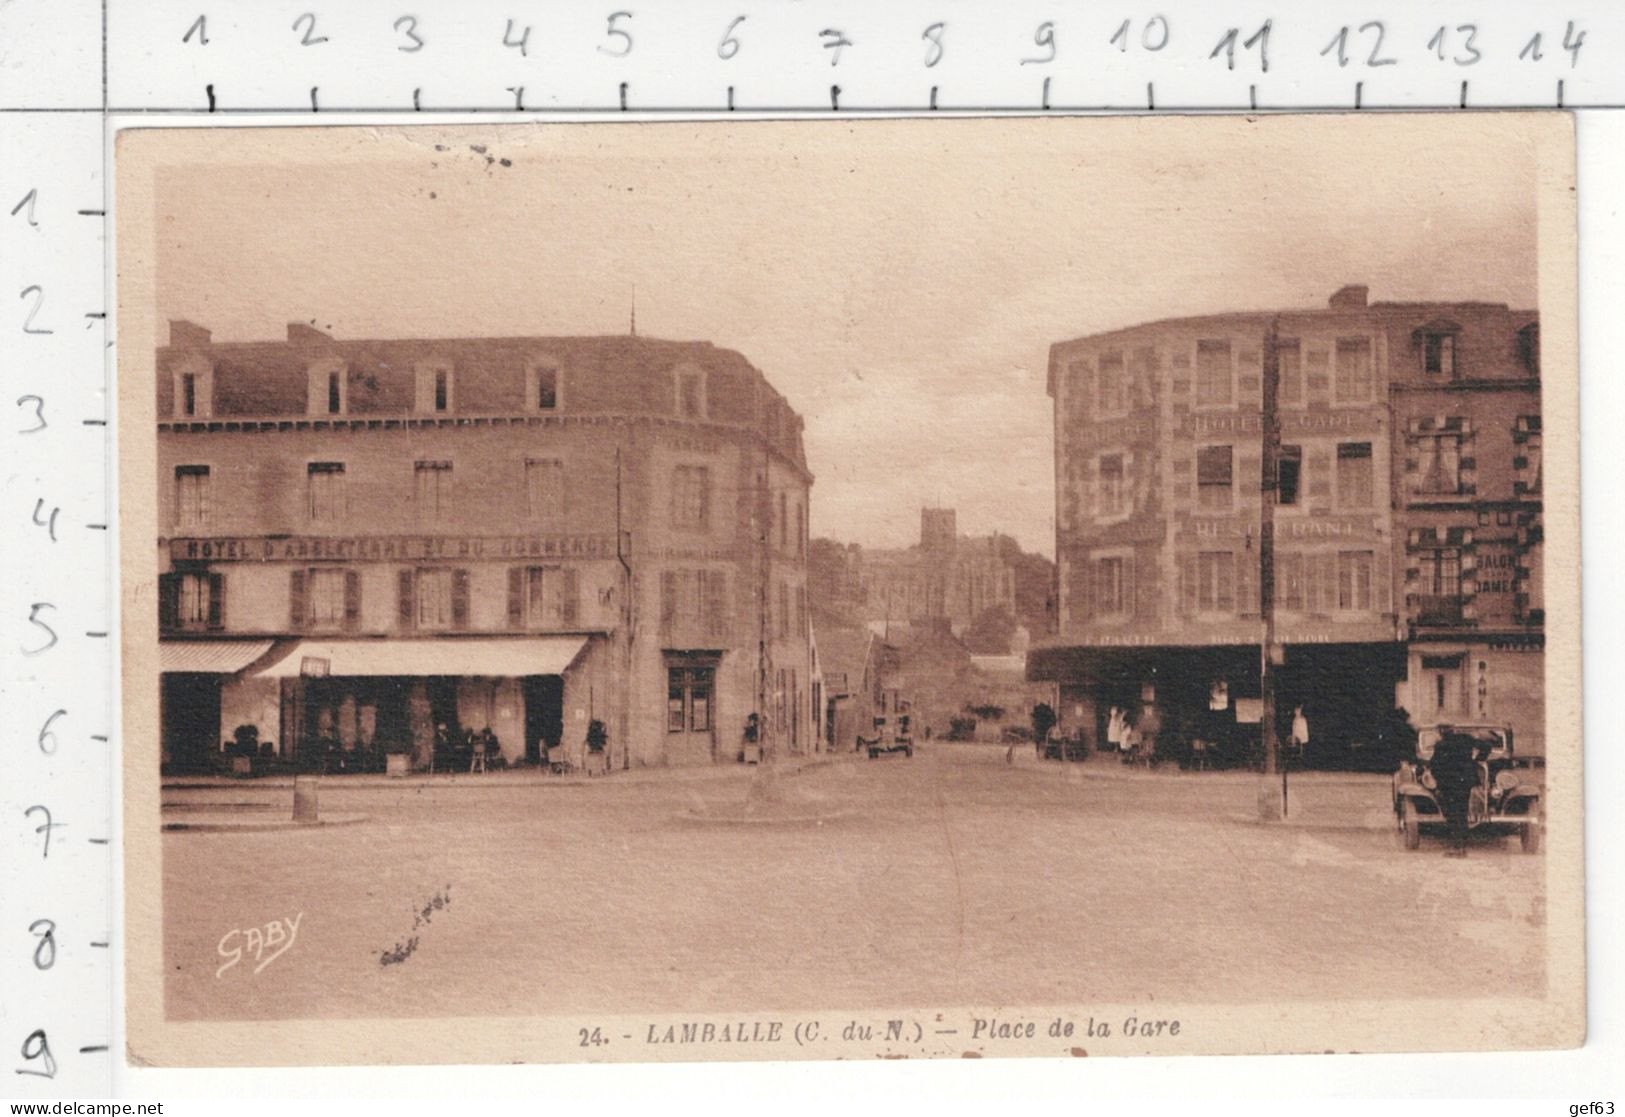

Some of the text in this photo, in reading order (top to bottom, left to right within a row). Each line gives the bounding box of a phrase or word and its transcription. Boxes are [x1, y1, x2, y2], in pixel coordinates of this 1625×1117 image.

[181, 10, 1588, 74] 1 2 3 4 5 6 7 8 9 10 11 12 13 14
[11, 188, 39, 227] 1
[20, 284, 55, 334] 2
[16, 394, 48, 434] 3
[32, 497, 60, 543] 4
[187, 540, 250, 557] HOTEL
[20, 602, 59, 657] 5
[38, 708, 68, 756] 6
[24, 804, 70, 859] 7
[28, 918, 57, 971] 8
[15, 1028, 57, 1079] 9
